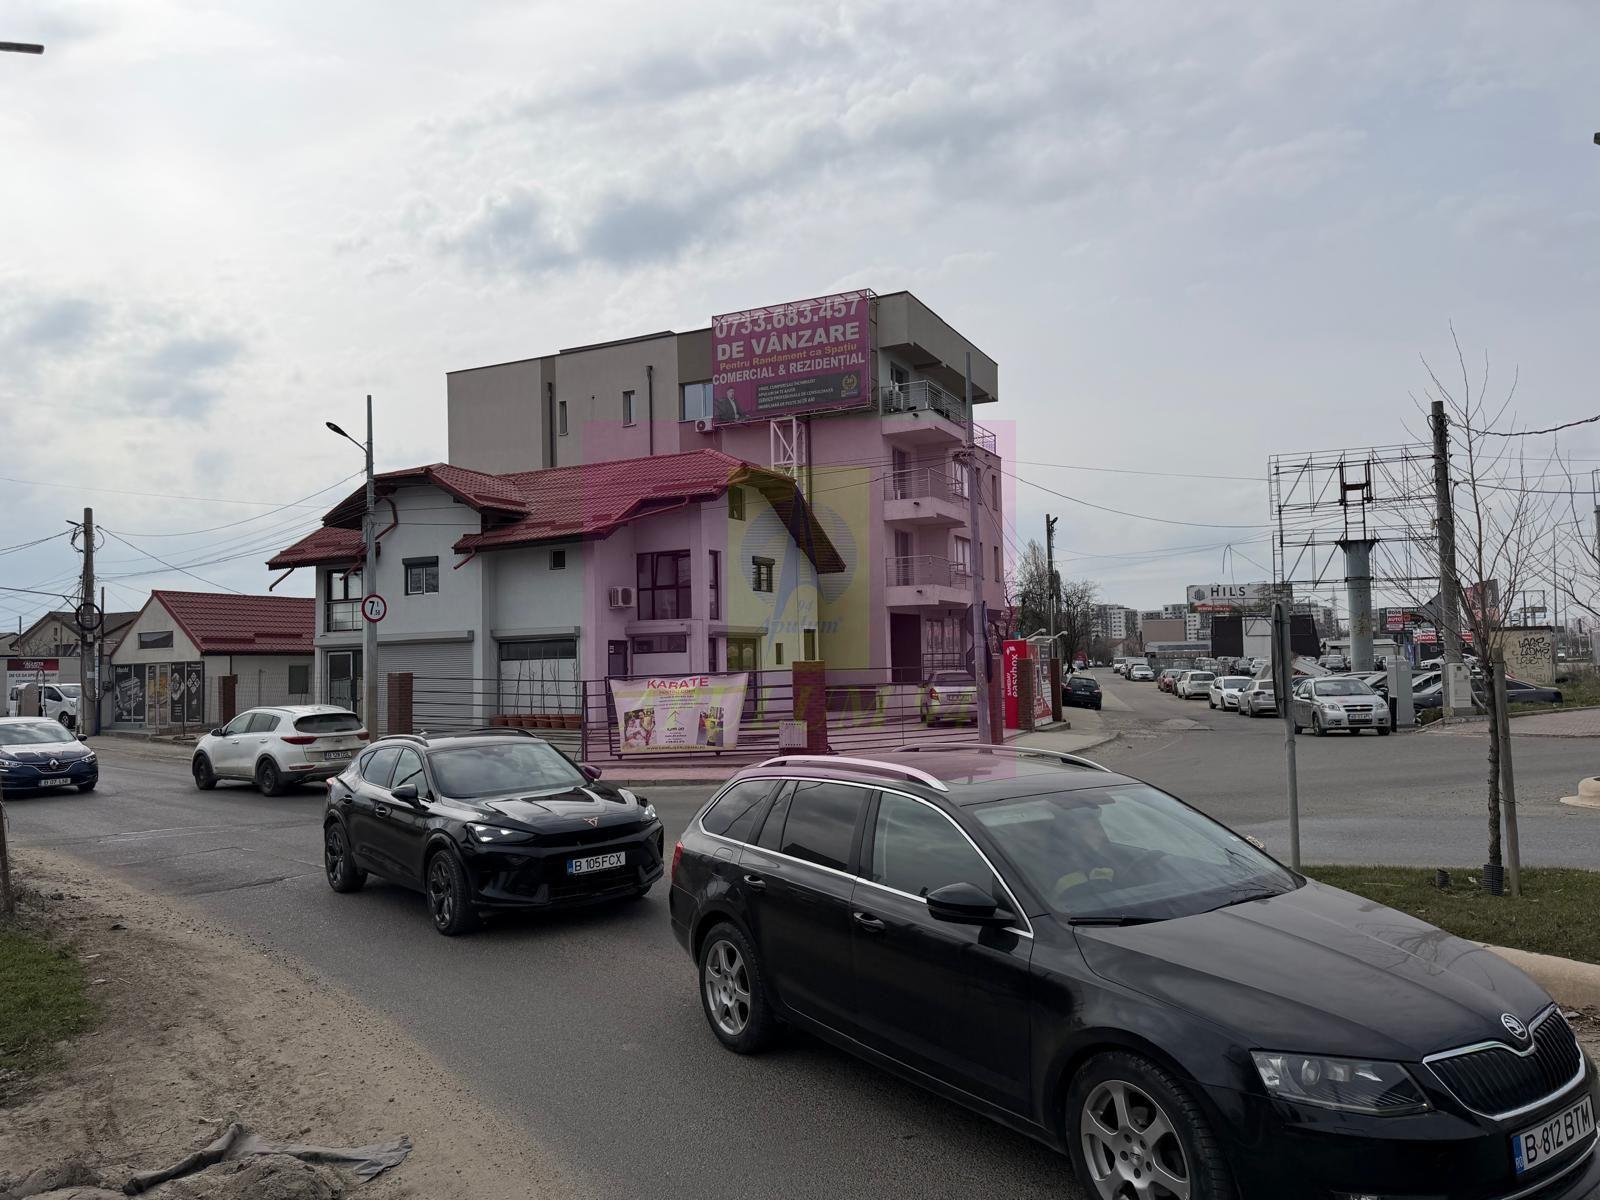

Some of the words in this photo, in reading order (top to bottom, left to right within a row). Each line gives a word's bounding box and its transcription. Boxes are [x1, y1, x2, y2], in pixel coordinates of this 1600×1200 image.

[715, 298, 860, 338] 0733.683.457
[717, 341, 745, 361] DE
[751, 321, 860, 355] VÂNZARE
[712, 368, 775, 385] COMERCIAL
[778, 365, 786, 375] &
[789, 352, 865, 374] REZIDENȚIAL
[720, 360, 749, 371] Pentru
[1211, 587, 1246, 597] HILS
[647, 677, 711, 690] KARATE
[574, 861, 582, 872] B
[585, 857, 601, 870] 105
[602, 854, 622, 868] FCX
[1525, 1134, 1538, 1164] B
[1542, 1119, 1564, 1155] 812
[1564, 1101, 1591, 1141] BTM
